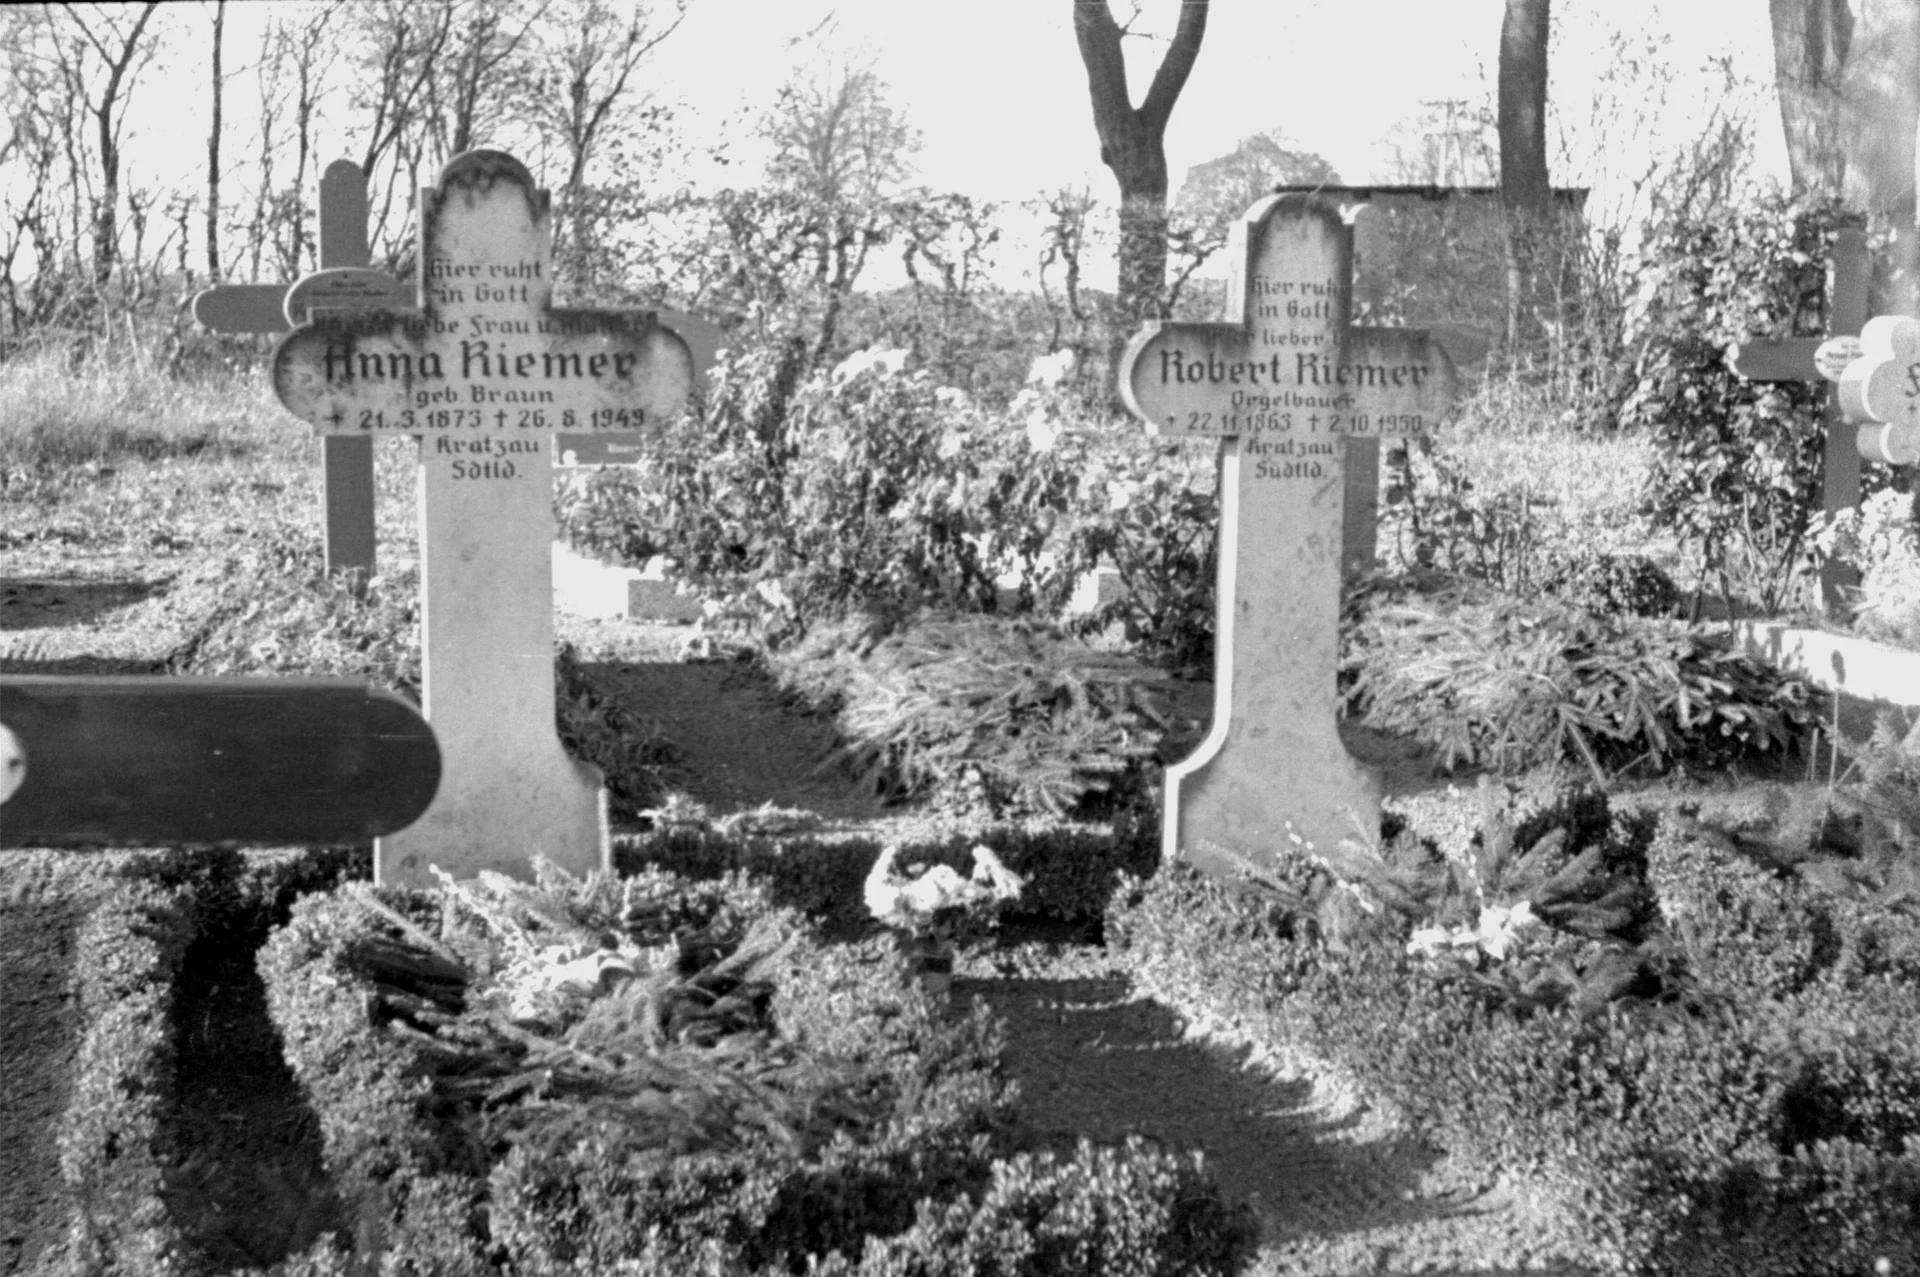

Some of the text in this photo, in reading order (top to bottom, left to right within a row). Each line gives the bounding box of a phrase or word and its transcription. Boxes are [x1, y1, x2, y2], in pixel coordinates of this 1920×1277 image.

[489, 260, 541, 279] ruht
[438, 283, 528, 303] in Gott
[1258, 299, 1329, 318] in Gott
[469, 314, 530, 338] Frau
[1263, 329, 1324, 347] lieber
[325, 340, 637, 382] Anna Riemer
[1160, 348, 1429, 386] Robert Riemer
[472, 385, 554, 404] Braun
[1231, 390, 1356, 412] Orgelbauer
[436, 434, 539, 458] Kratzau
[1246, 437, 1334, 458] Kratzau
